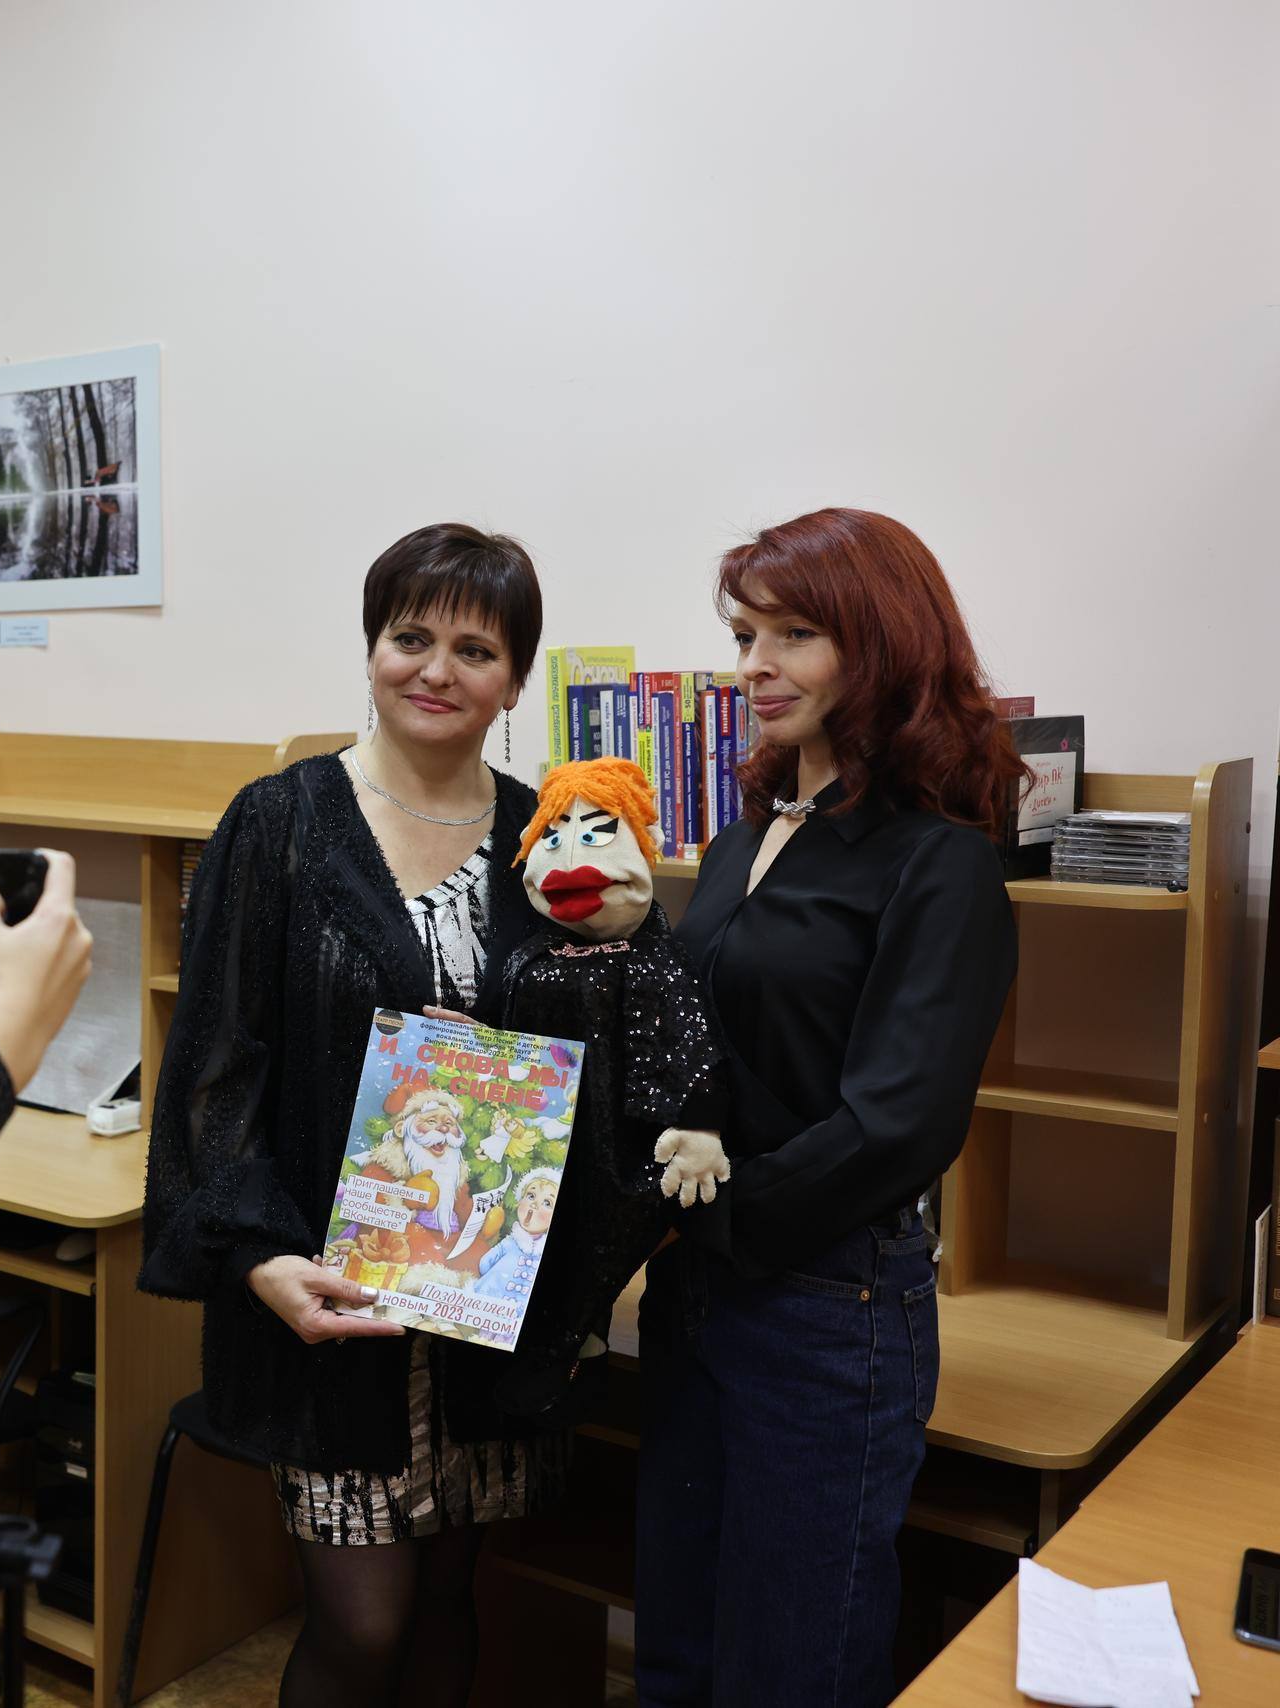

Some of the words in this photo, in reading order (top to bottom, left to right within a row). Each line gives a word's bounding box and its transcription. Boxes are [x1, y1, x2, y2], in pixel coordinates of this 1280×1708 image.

[572, 697, 580, 738] ПОДГОТОВКА
[685, 723, 691, 731] XP
[721, 696, 729, 733] информатика
[573, 739, 581, 762] ТЕРНАЯ
[420, 1022, 469, 1037] формирований
[521, 1041, 551, 1052] детского
[436, 1033, 474, 1045] вокального
[475, 1041, 507, 1051] ансамбля
[437, 1018, 483, 1033] Музыкальный
[483, 1028, 509, 1039] журнал
[509, 1031, 537, 1041] клубных
[378, 1035, 398, 1056] И
[416, 1044, 510, 1081] СНОВА
[527, 1064, 568, 1090] МЫ
[424, 1036, 449, 1047] Выпуск
[450, 1042, 461, 1050] №1
[463, 1044, 487, 1055] Январь
[516, 1054, 541, 1064] Рассвет
[391, 1063, 429, 1088] НА
[449, 1076, 546, 1111] СЦЕНЕ
[344, 1188, 372, 1200] наше
[347, 1174, 414, 1200] Приглашаем
[418, 1193, 425, 1201] в
[342, 1198, 408, 1221] сообщество
[382, 1294, 429, 1313] новым
[432, 1302, 462, 1322] 2023
[464, 1314, 518, 1335] годом!
